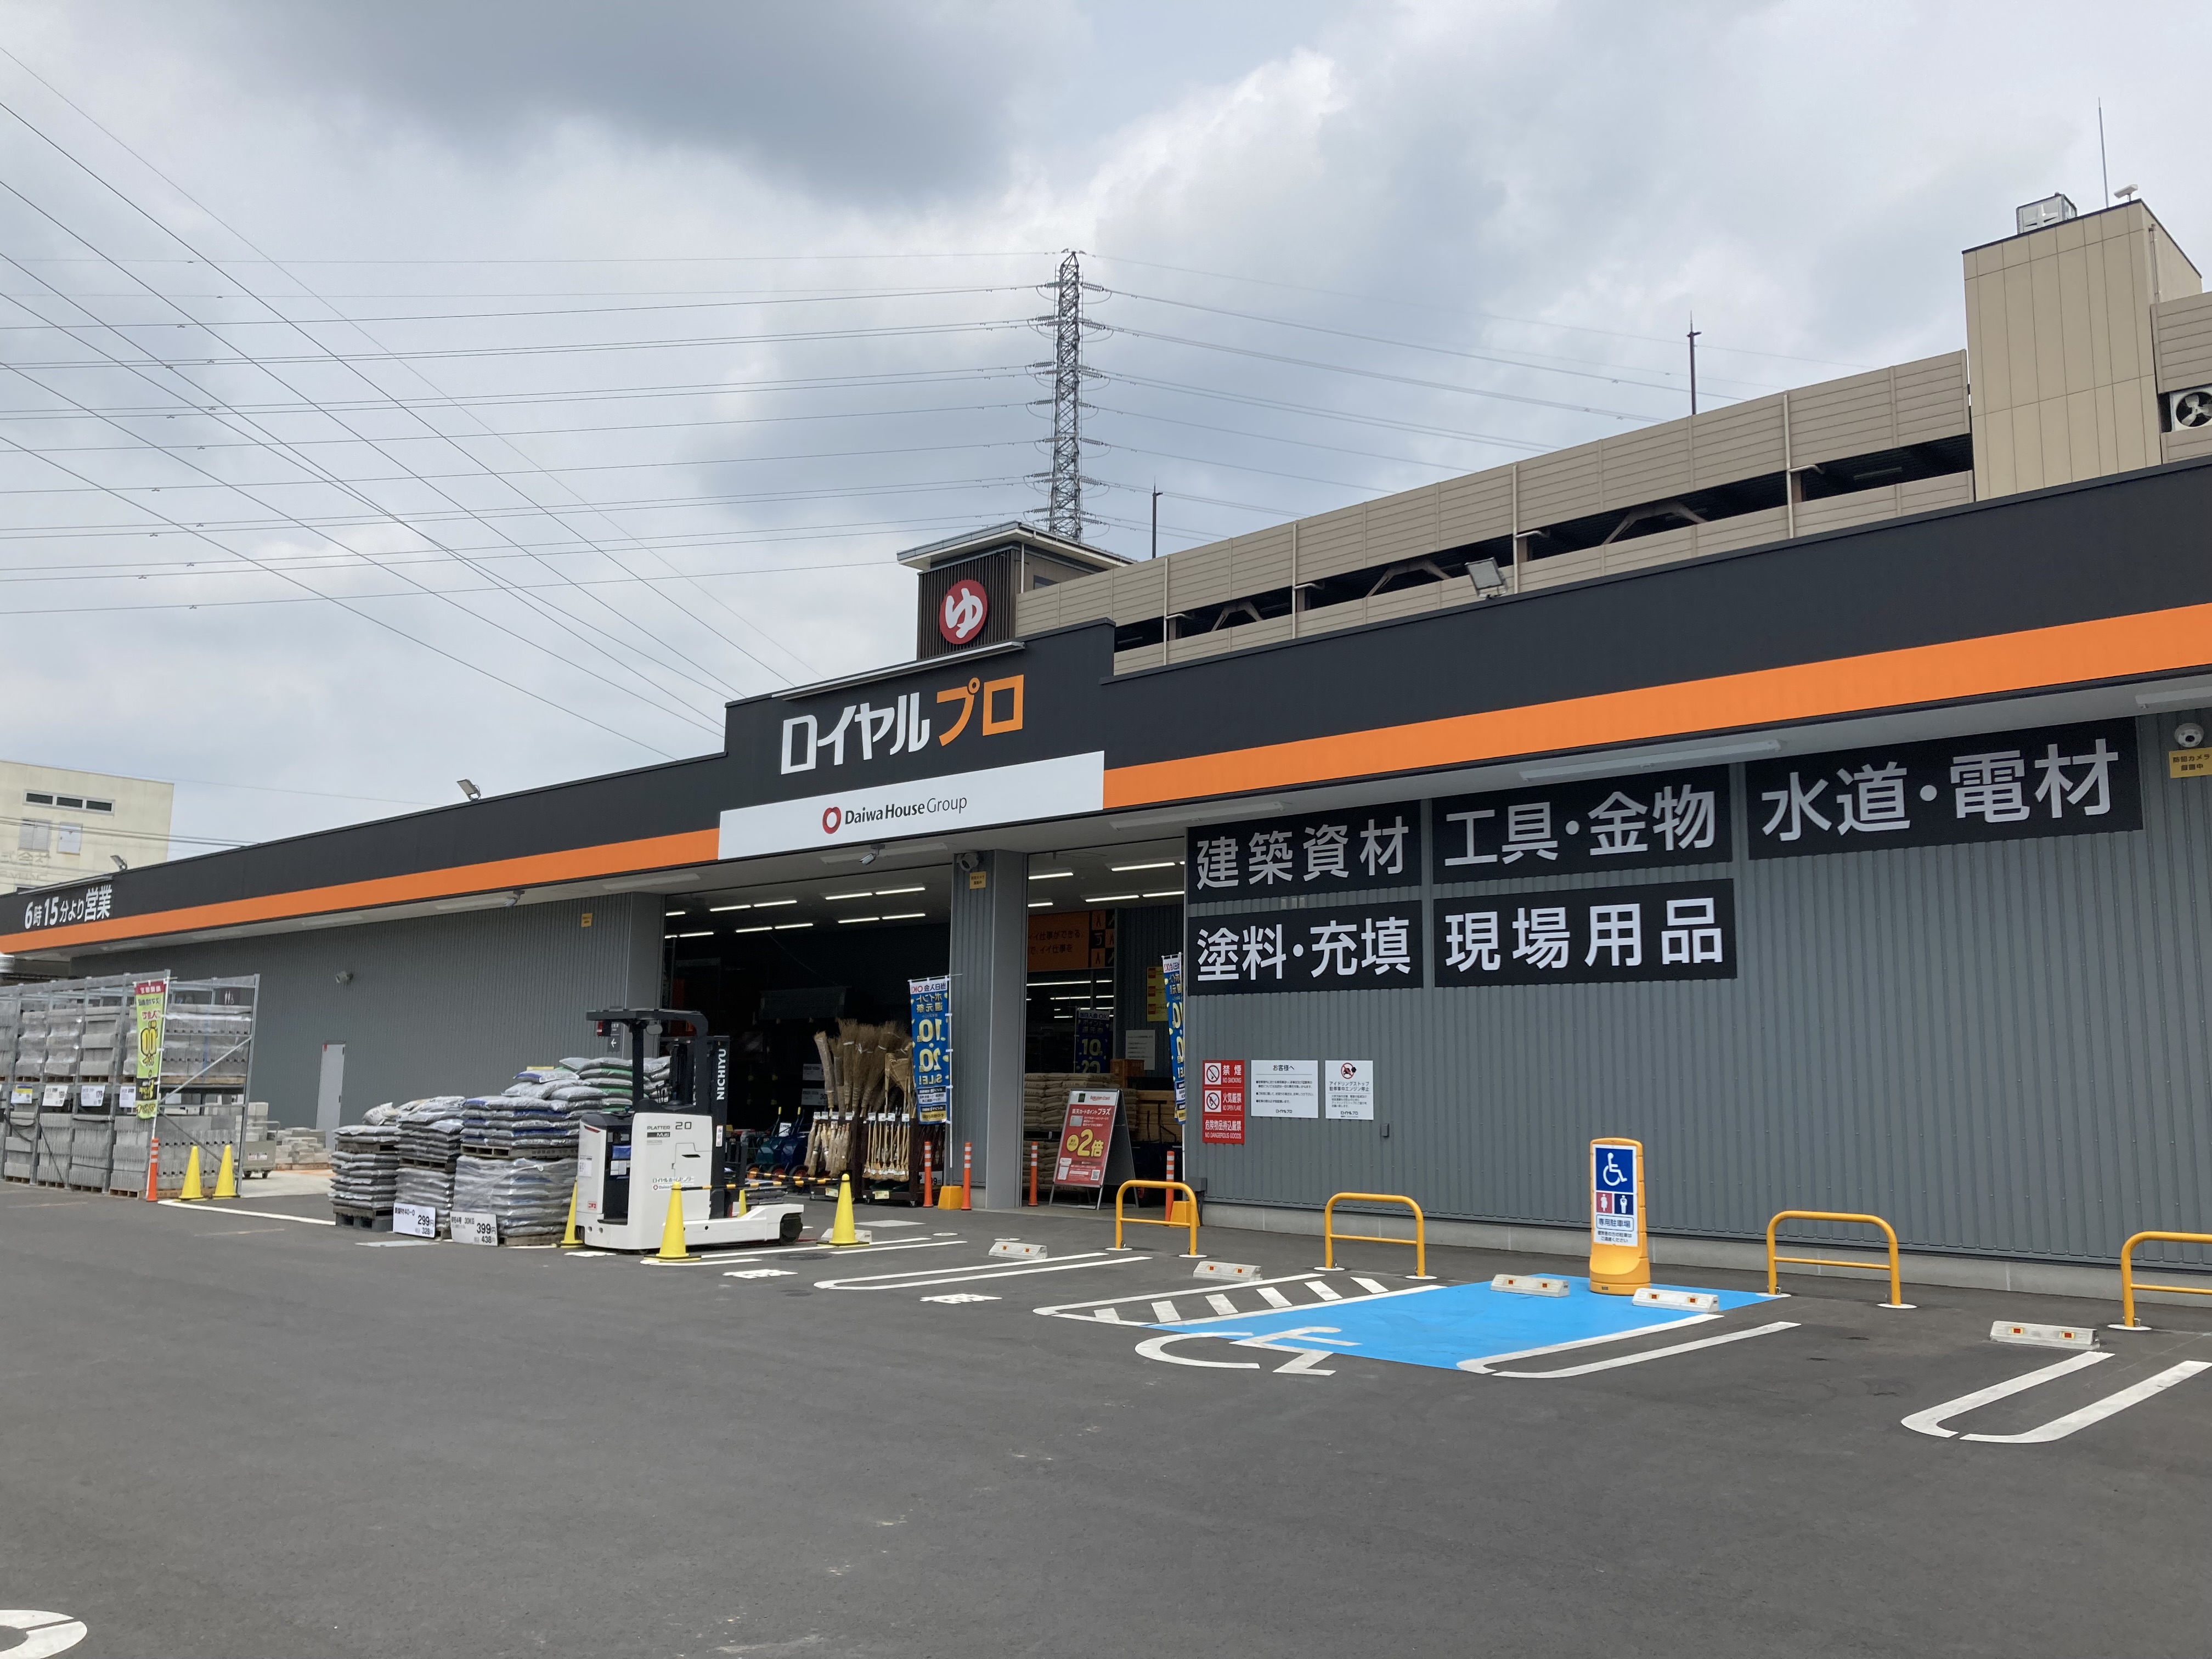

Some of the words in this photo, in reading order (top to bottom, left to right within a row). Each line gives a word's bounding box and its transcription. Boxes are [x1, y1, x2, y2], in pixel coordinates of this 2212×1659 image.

[945, 588, 984, 639] ゆ
[781, 674, 1024, 775] ロイヤルプロ
[927, 795, 968, 814] Group
[1761, 738, 2119, 842] 水道・電材
[1196, 816, 1409, 891] 建築資材
[1444, 784, 1716, 867] 工具・金物
[1196, 916, 1412, 981] 塗料・充填
[1444, 897, 1725, 973] 現場用品
[716, 1049, 726, 1101] NICHIYU
[1222, 1065, 1242, 1076] 禁煙
[675, 1121, 692, 1130] 20
